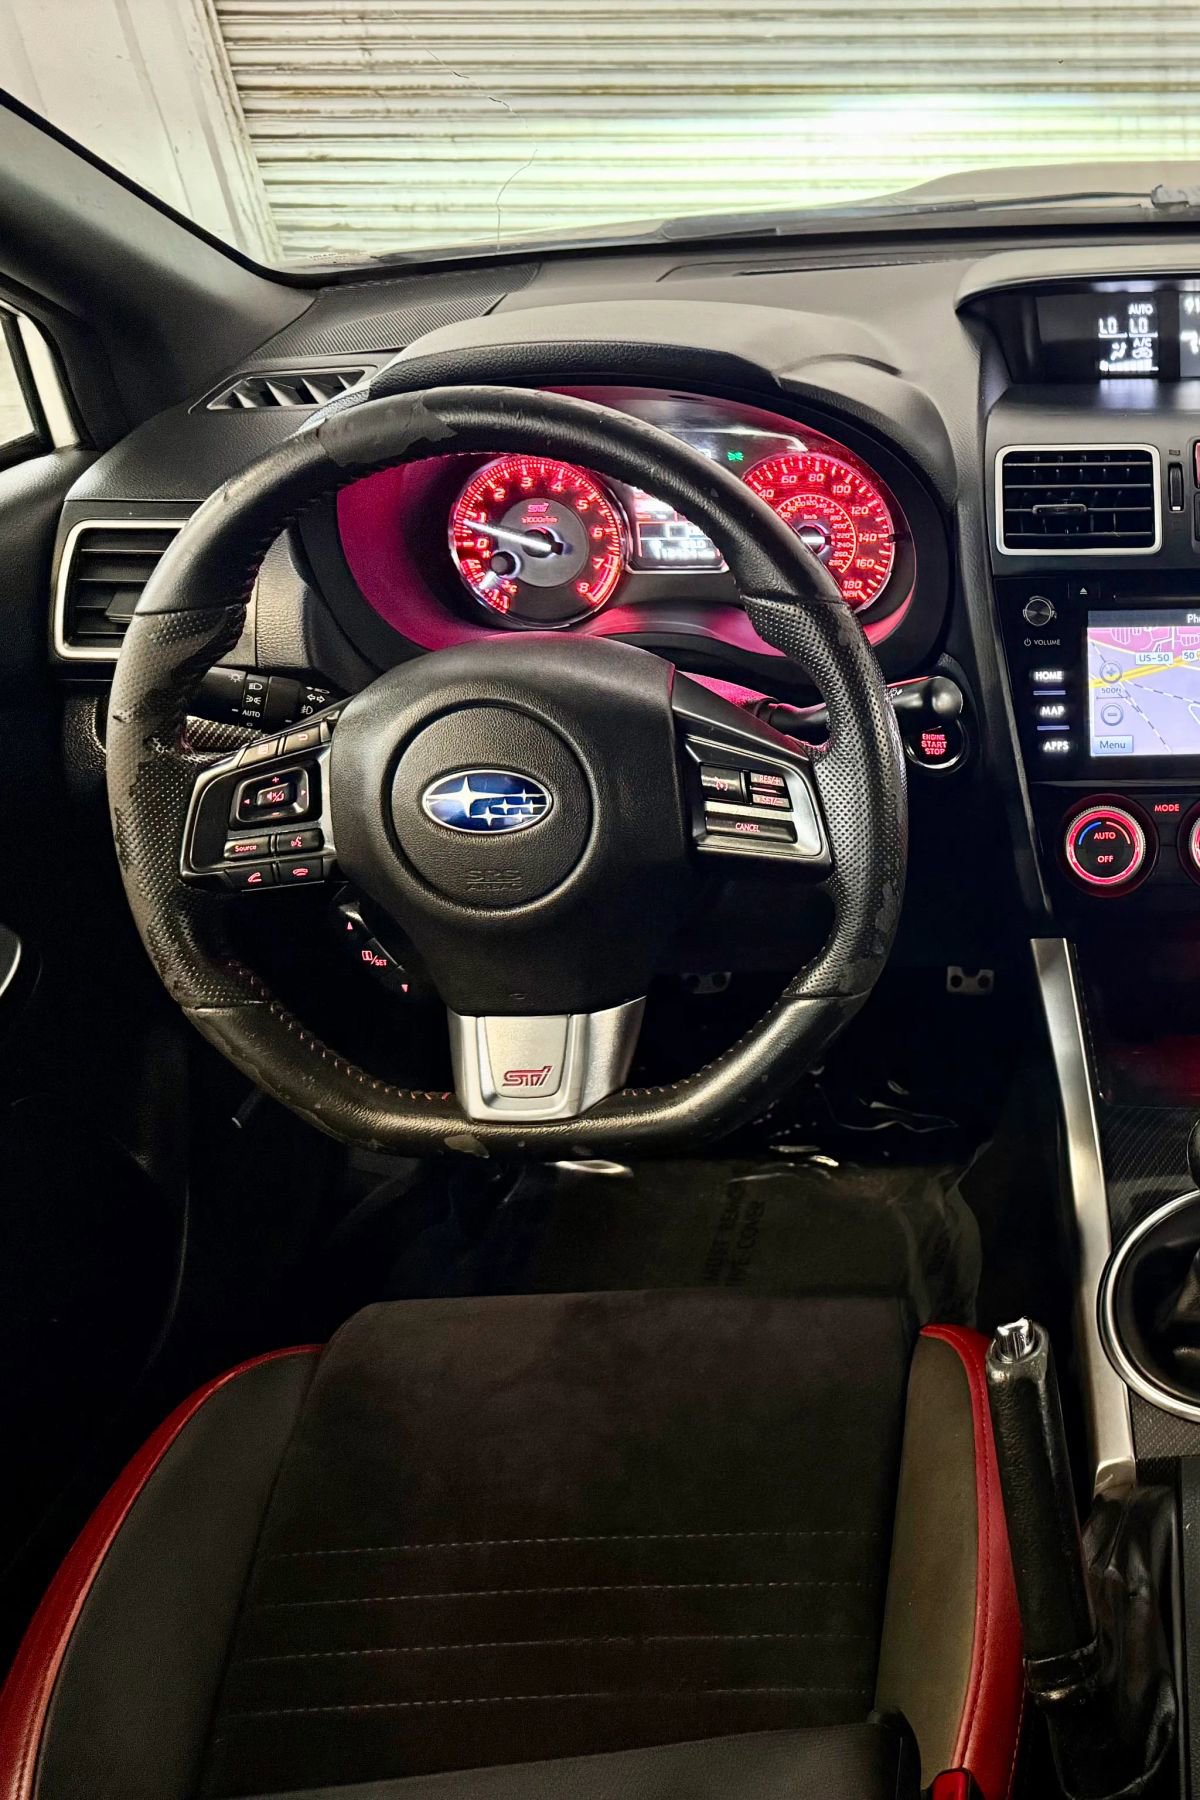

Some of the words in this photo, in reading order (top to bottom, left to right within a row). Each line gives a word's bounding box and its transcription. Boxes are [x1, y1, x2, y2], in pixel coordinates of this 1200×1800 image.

[1128, 303, 1153, 315] AUTO
[521, 477, 533, 488] 3
[781, 475, 797, 484] 60
[808, 473, 824, 484] 80
[551, 480, 563, 491] 4
[832, 485, 851, 494] 100
[494, 488, 505, 499] 2
[577, 499, 589, 509] 5
[851, 506, 869, 515] 120
[592, 527, 603, 538] 6
[858, 533, 877, 541] 140
[477, 538, 488, 549] 0
[593, 558, 604, 569] 7
[856, 559, 875, 568] 160
[578, 582, 590, 592] 8
[843, 580, 862, 589] 180
[1139, 653, 1169, 662] US-50
[1183, 652, 1195, 660] 50
[1034, 670, 1063, 681] HOME
[242, 709, 261, 718] AUTO
[1041, 706, 1065, 717] MAP
[921, 733, 946, 741] ENGINE
[921, 740, 948, 749] START
[1043, 740, 1070, 752] APPS
[1099, 739, 1126, 750] Menu
[1154, 804, 1180, 813] MODE
[735, 822, 760, 832] CANCEL
[1093, 831, 1116, 840] AUTO
[234, 844, 257, 852] Source
[1097, 855, 1114, 863] OFF
